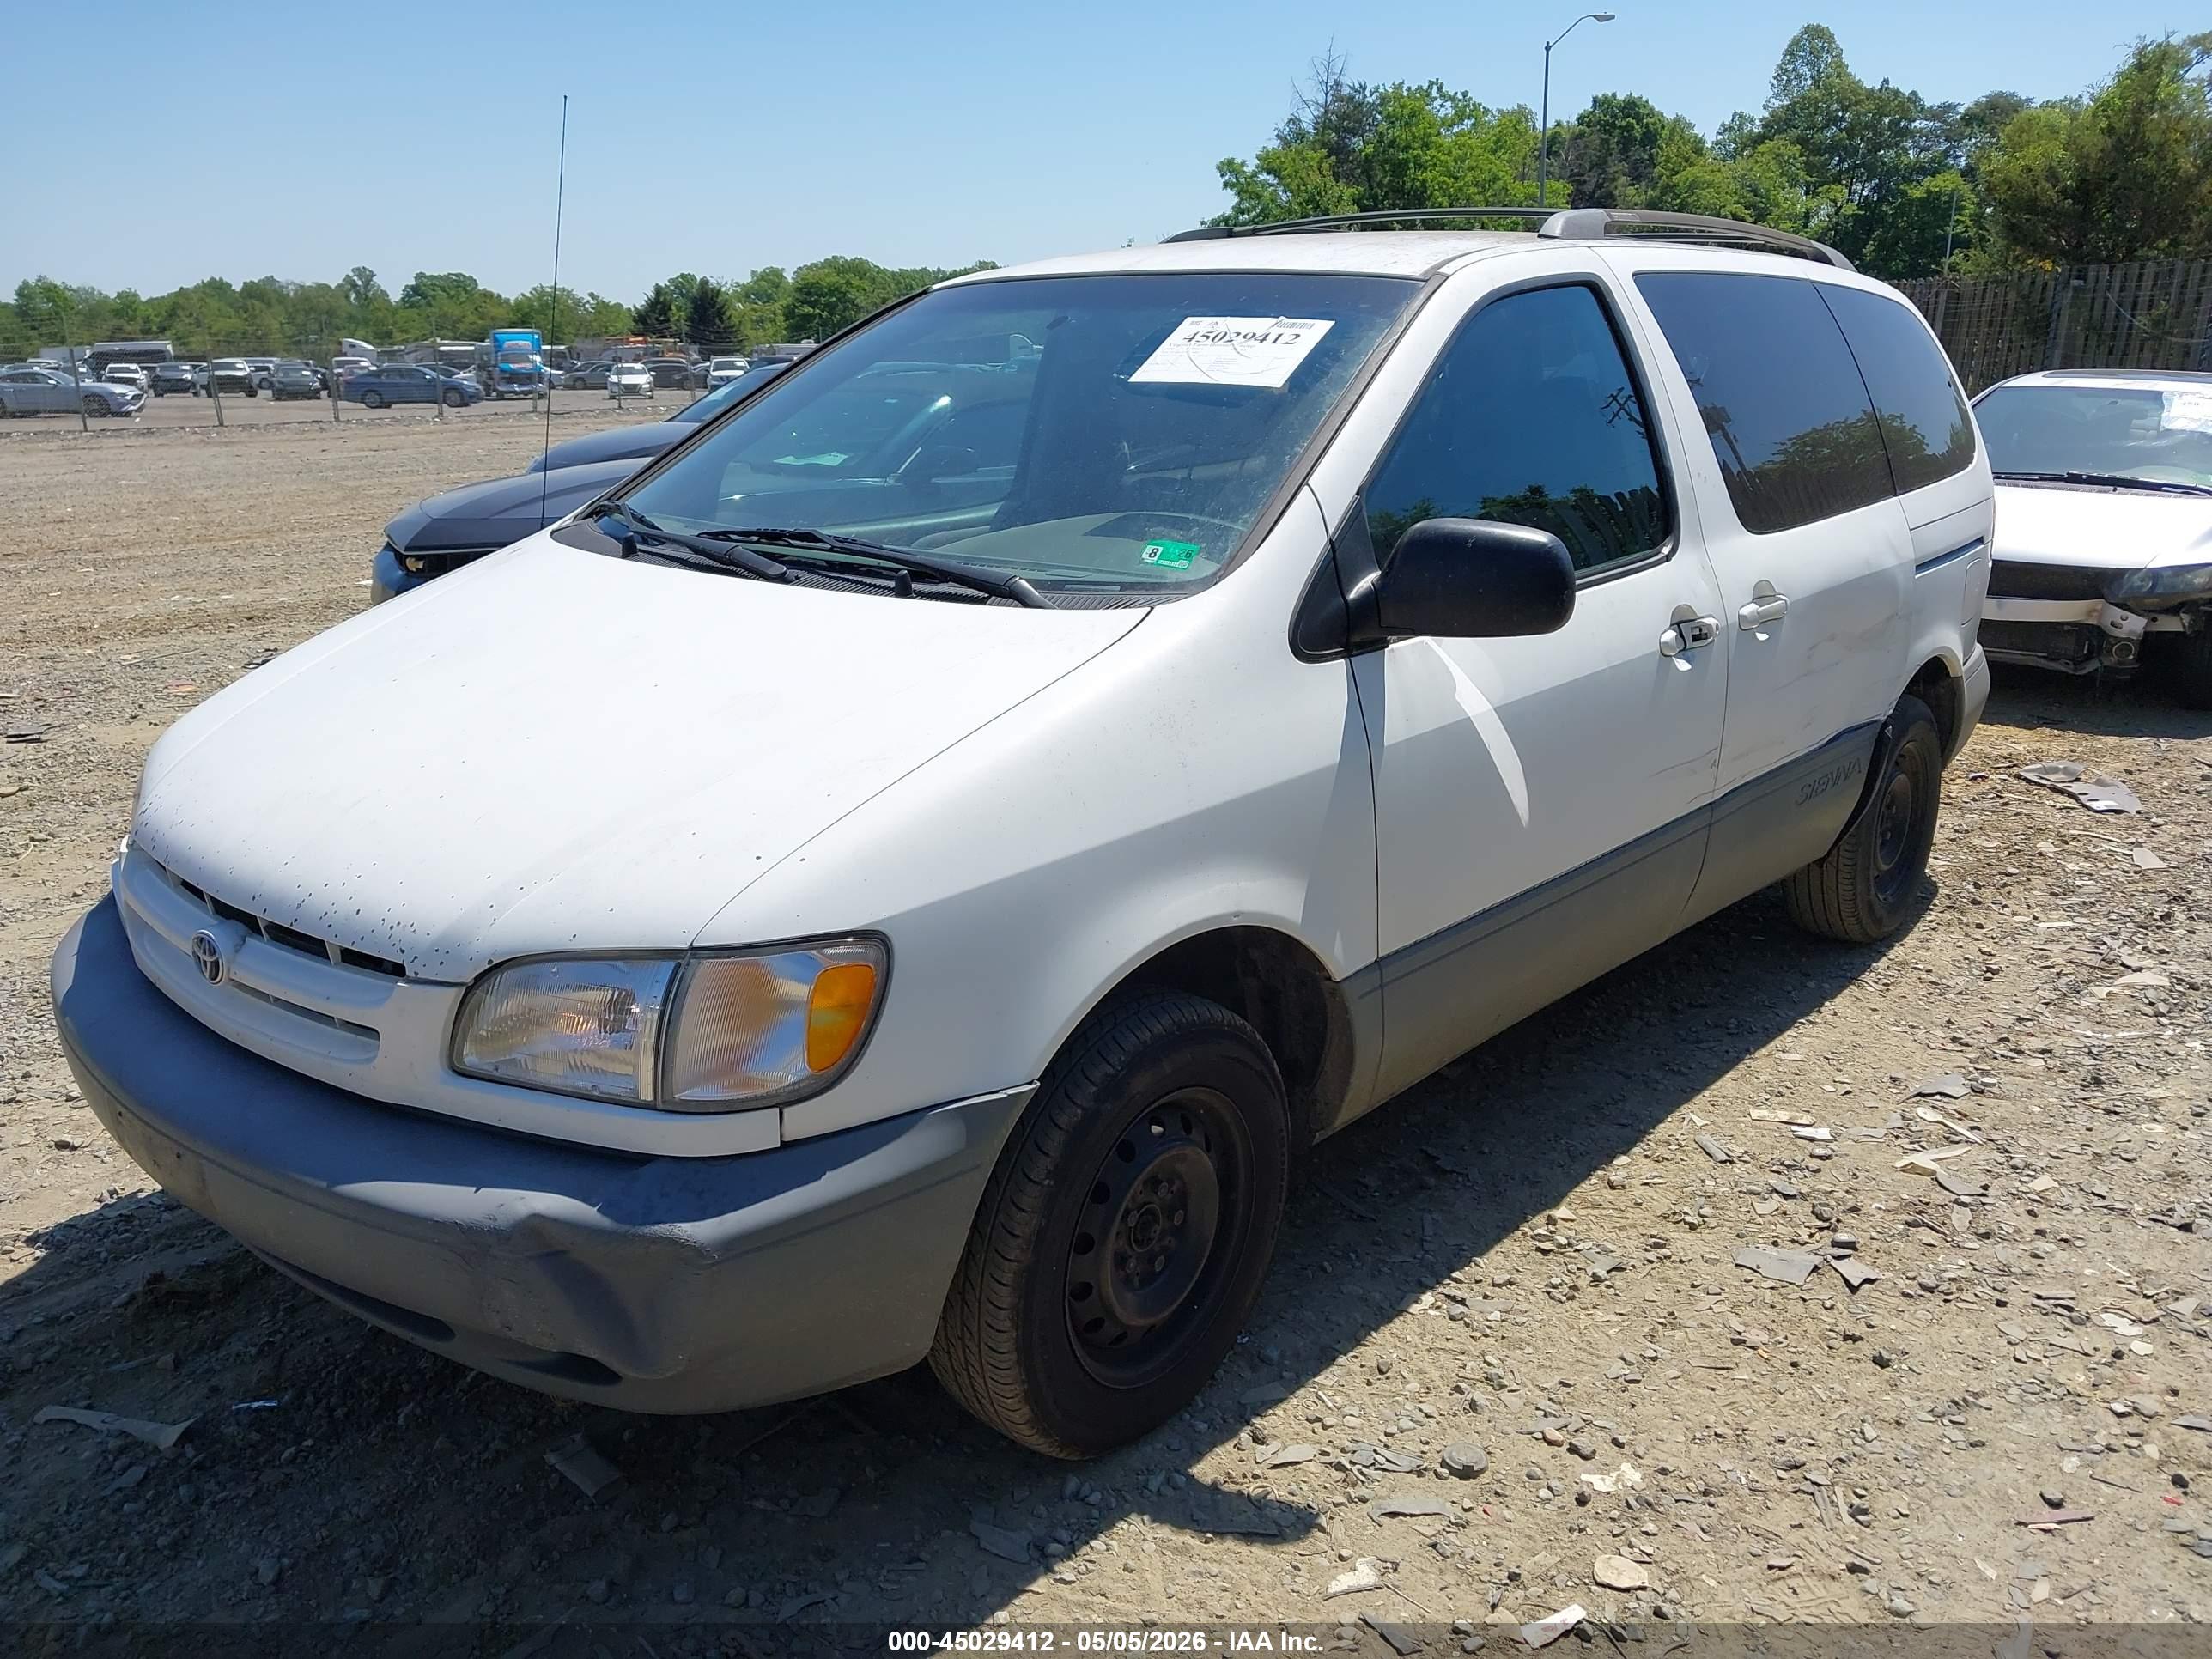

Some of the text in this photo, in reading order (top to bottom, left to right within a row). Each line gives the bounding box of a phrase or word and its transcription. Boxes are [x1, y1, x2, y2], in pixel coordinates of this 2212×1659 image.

[1183, 330, 1301, 345] 45029412
[1148, 548, 1159, 558] 8
[1796, 758, 1862, 805] SIENNA
